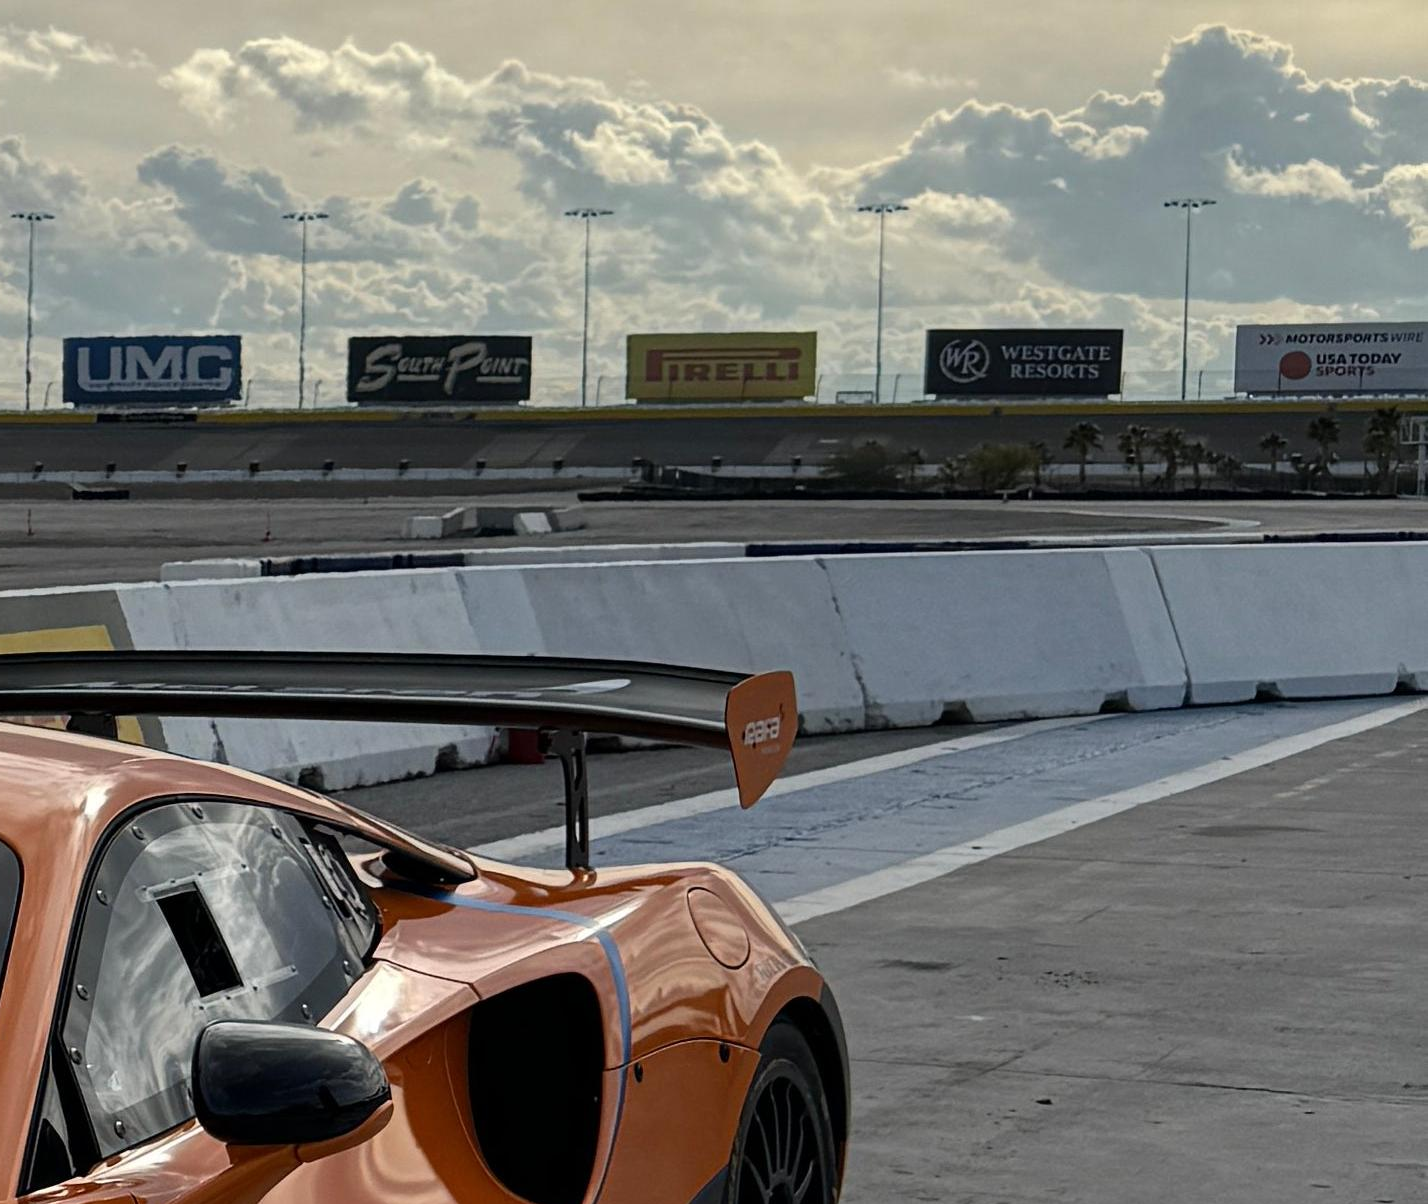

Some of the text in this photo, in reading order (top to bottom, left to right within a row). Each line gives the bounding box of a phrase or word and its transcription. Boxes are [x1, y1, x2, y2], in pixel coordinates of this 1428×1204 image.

[1286, 331, 1425, 344] MOTORSPORTS WIRE
[1000, 345, 1111, 361] WESTGATE
[1316, 352, 1403, 365] USA TODAY
[76, 345, 233, 391] UMC
[645, 347, 802, 382] PIRELLI
[1010, 363, 1100, 379] RESORTS
[1316, 366, 1376, 377] SPORTS
